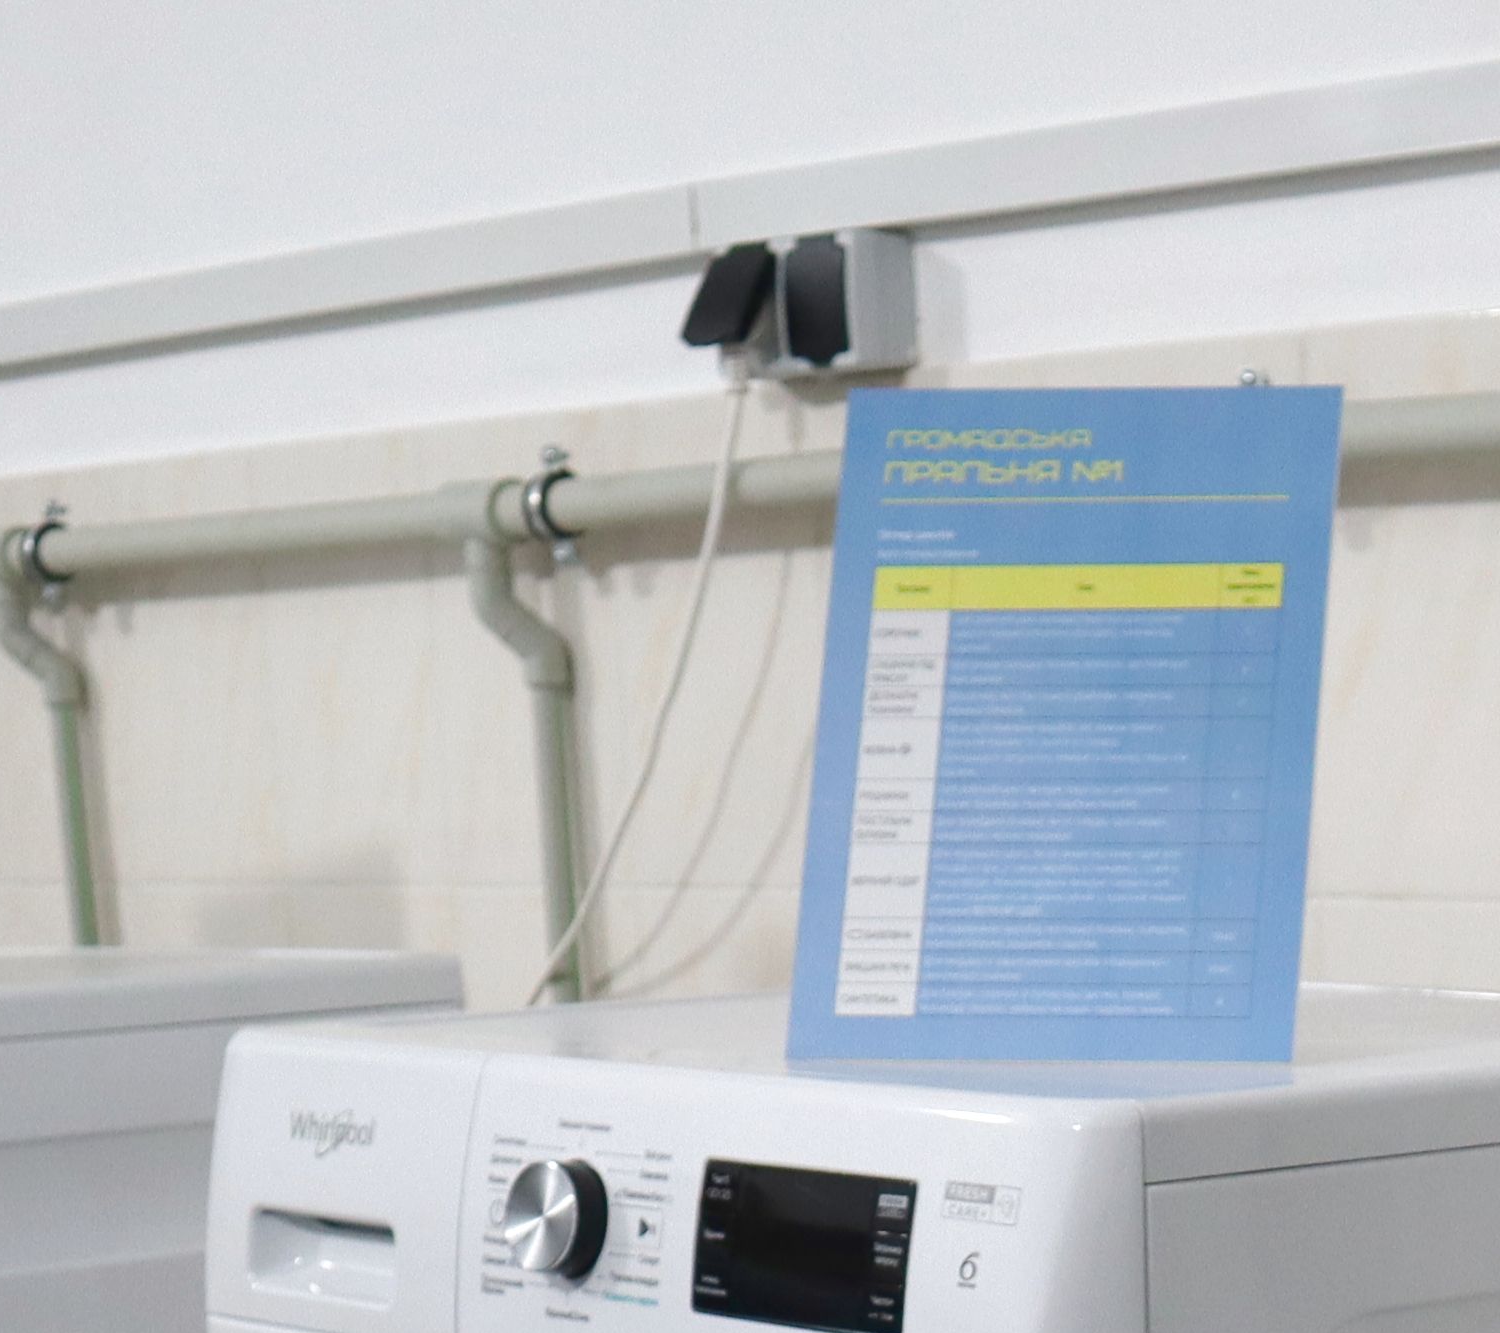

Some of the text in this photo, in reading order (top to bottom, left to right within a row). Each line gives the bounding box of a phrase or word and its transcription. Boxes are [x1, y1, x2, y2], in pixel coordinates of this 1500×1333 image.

[886, 427, 1093, 450] ГРОМАДСЬКА
[884, 459, 1061, 484] ПРАЛЬНЯ
[289, 1107, 376, 1157] Whirlpool
[958, 1251, 980, 1282] 6
